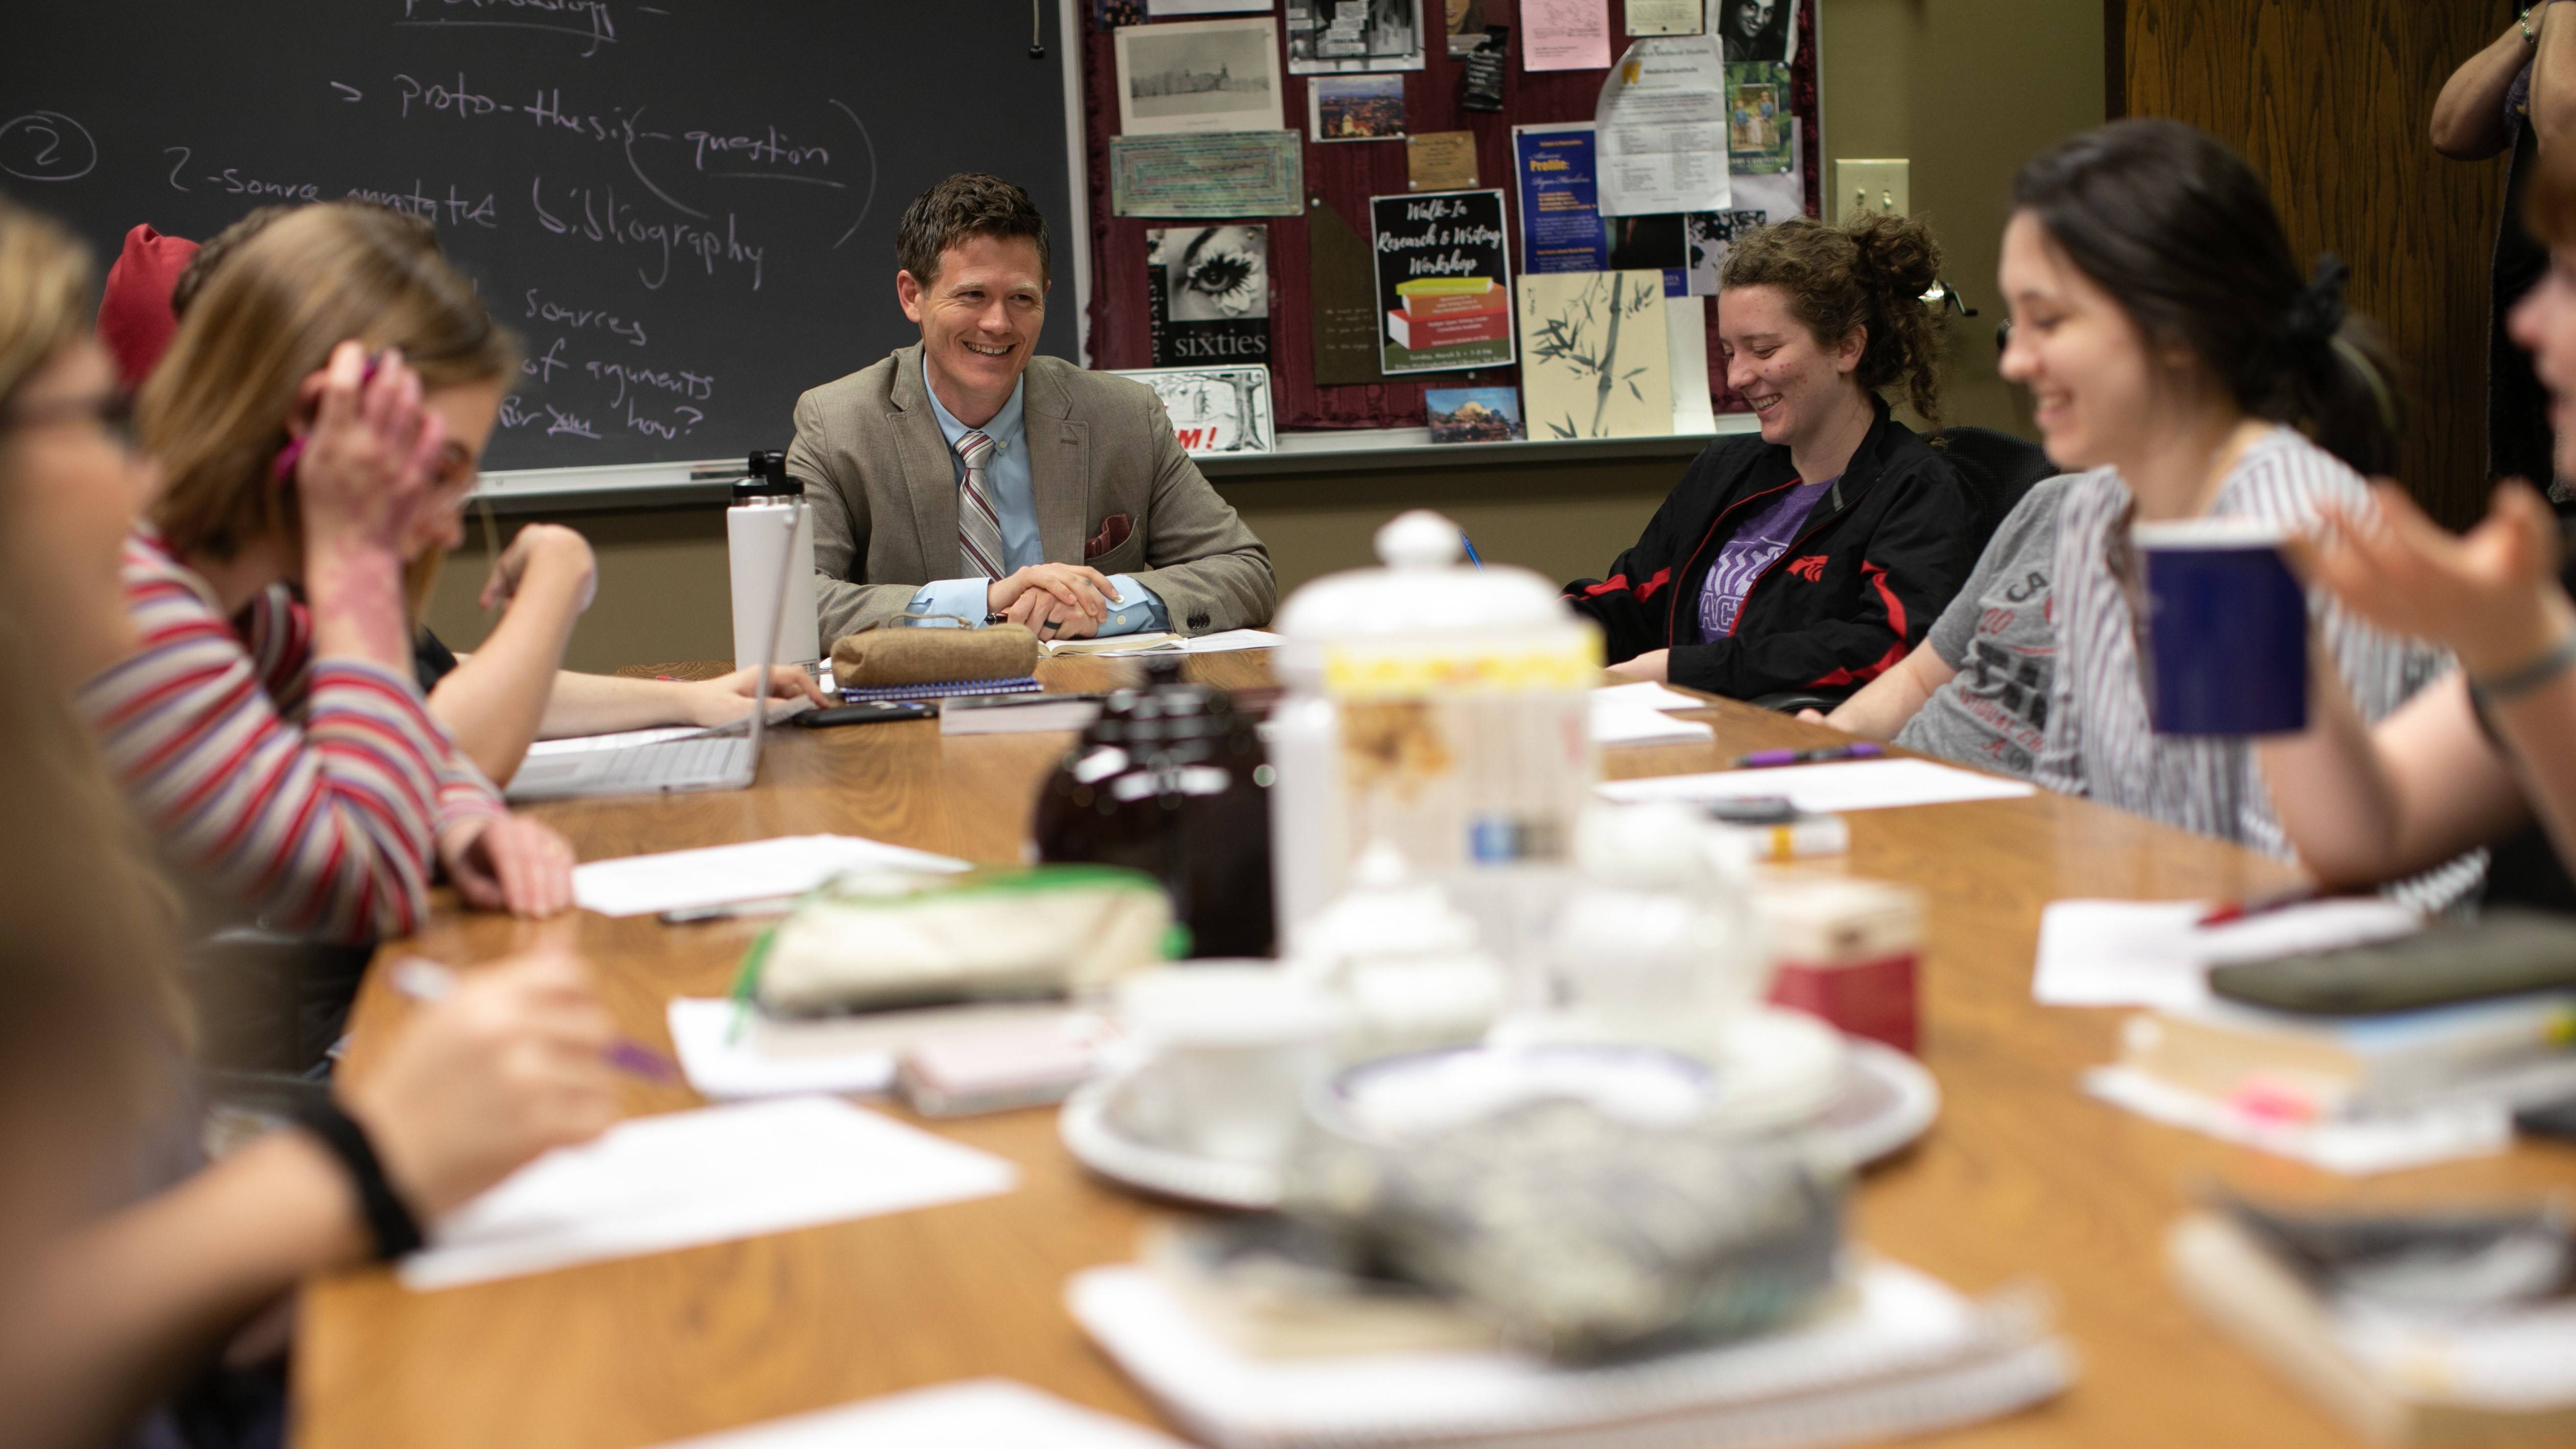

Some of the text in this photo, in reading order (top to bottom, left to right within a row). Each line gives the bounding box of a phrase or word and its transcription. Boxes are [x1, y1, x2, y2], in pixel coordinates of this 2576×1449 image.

[25, 126, 61, 166] 2
[1407, 199, 1468, 221] Walk-In
[532, 176, 765, 291] bibliography
[1377, 223, 1502, 253] Research & Writing
[1409, 248, 1478, 277] Workshop
[1175, 328, 1267, 357] sixties
[521, 337, 568, 383] of
[627, 397, 703, 440] how?
[1173, 426, 1217, 450] M!
